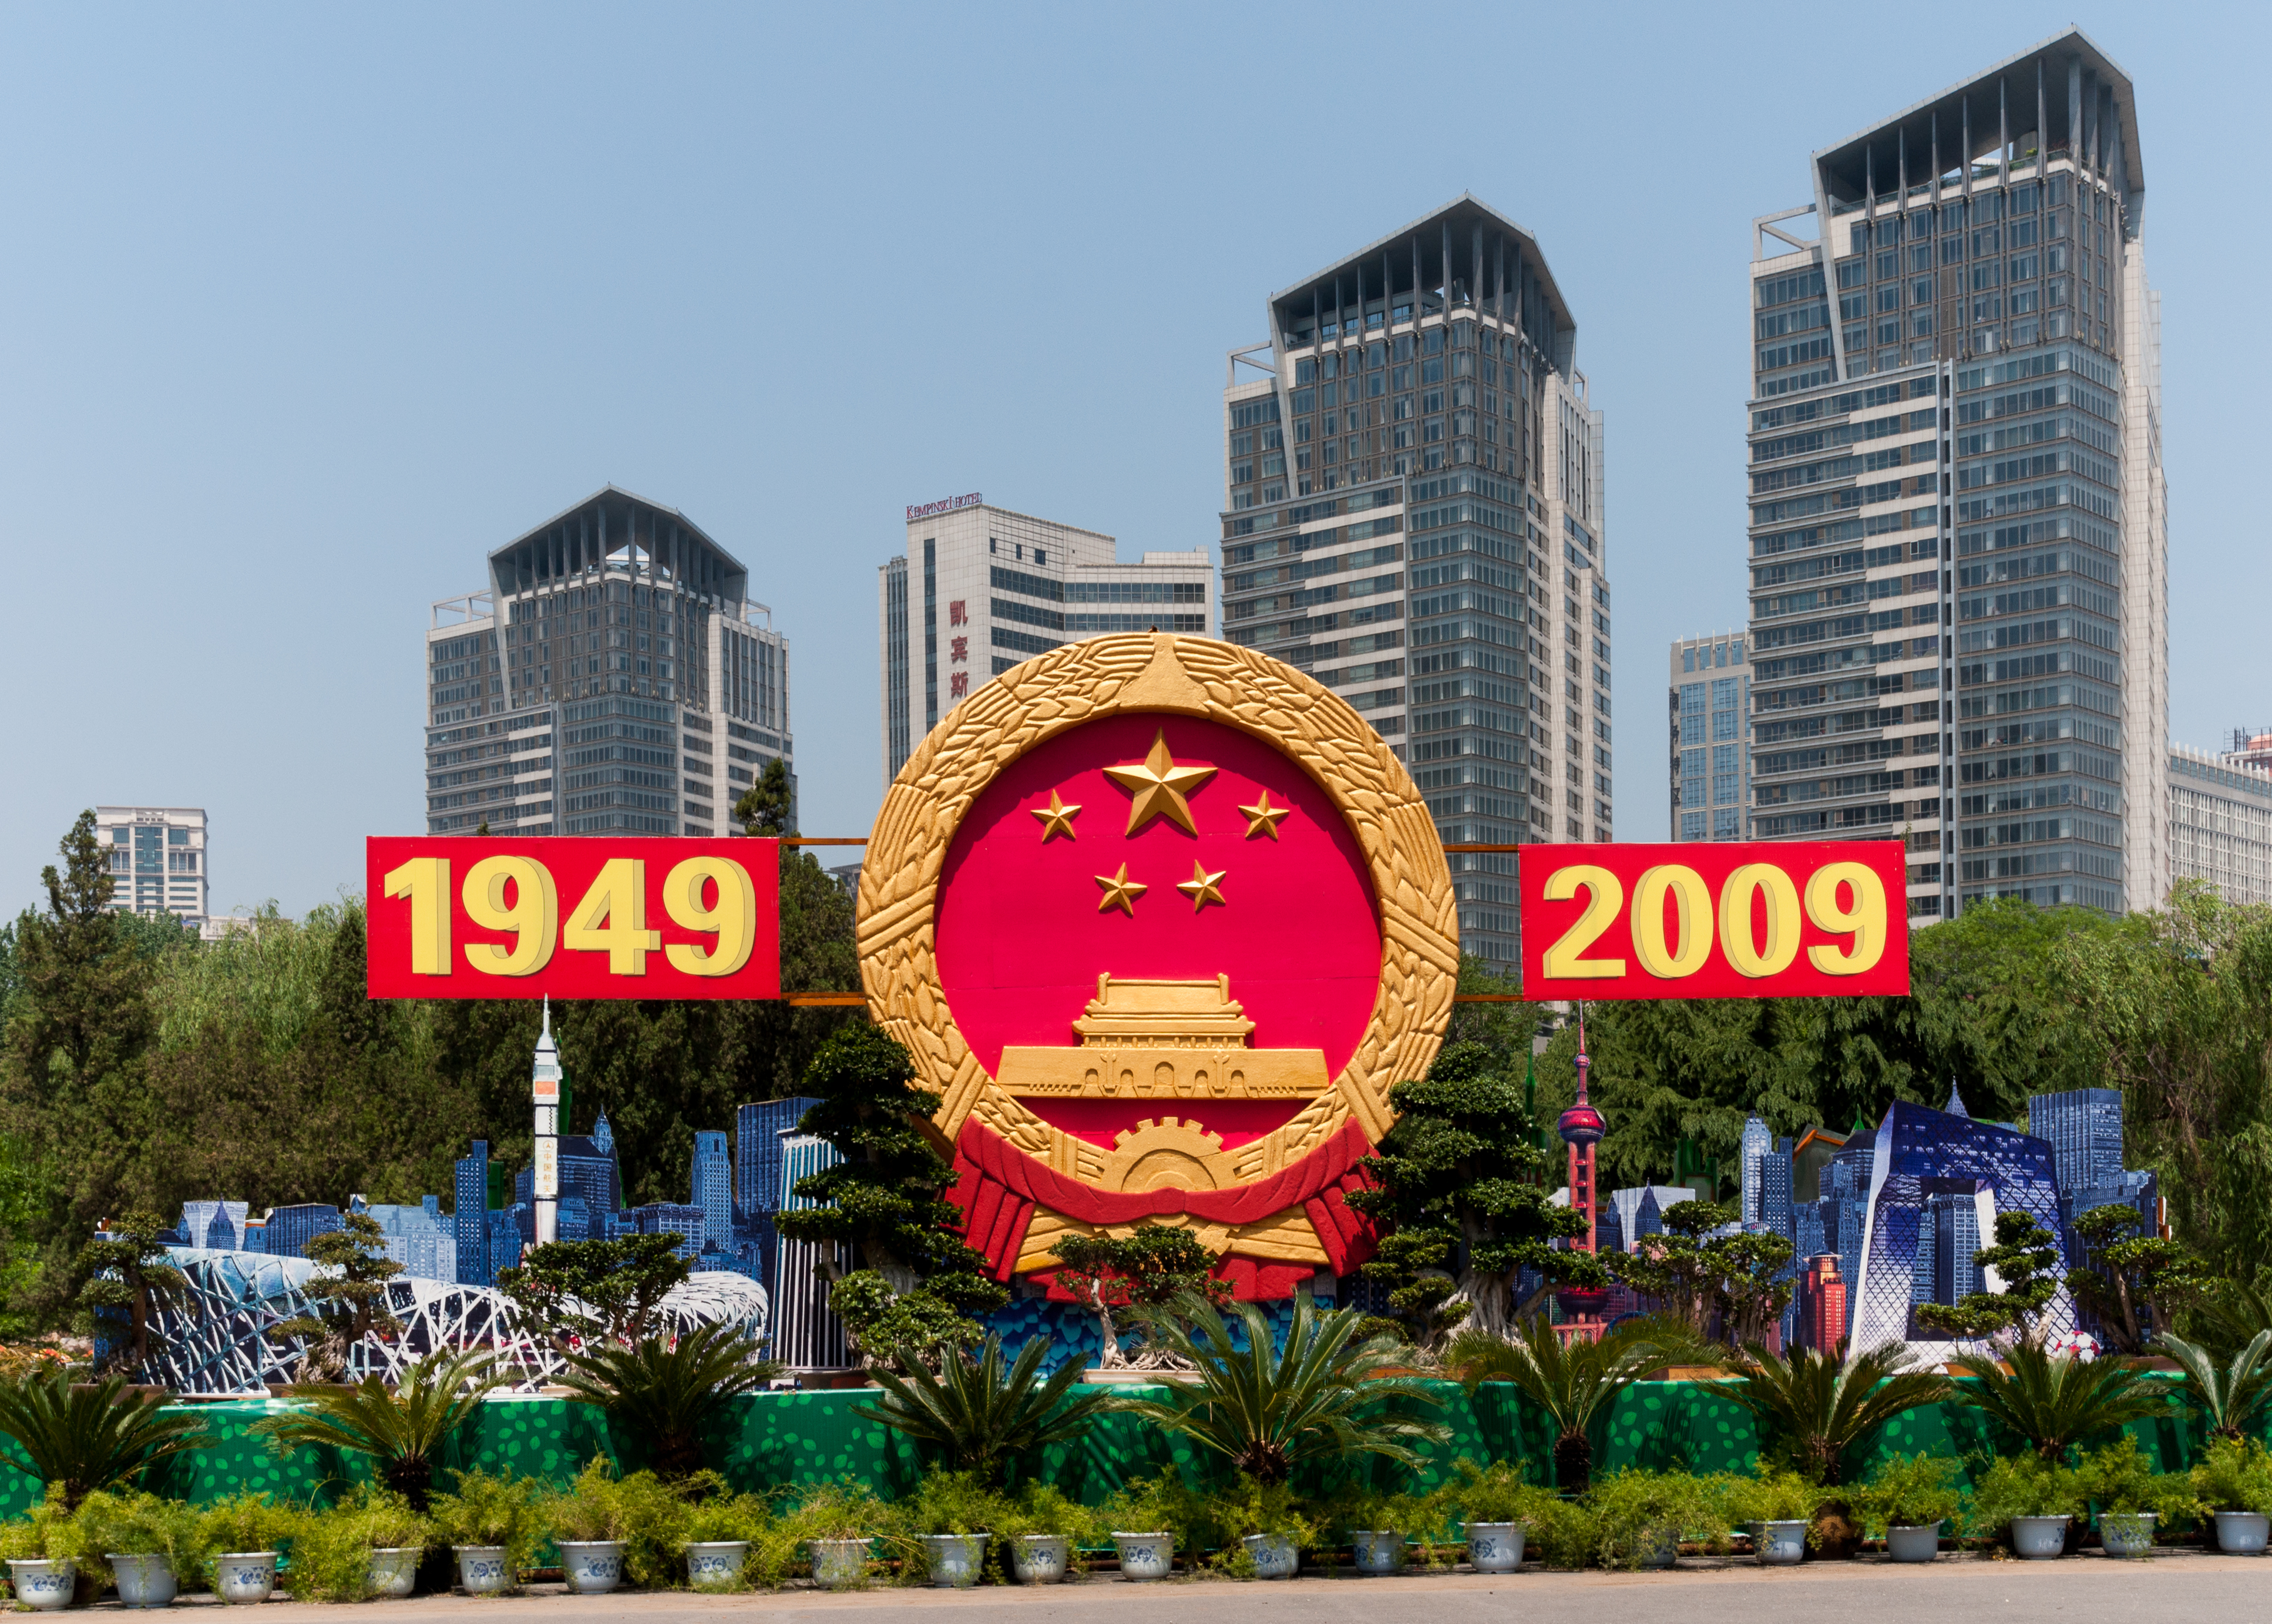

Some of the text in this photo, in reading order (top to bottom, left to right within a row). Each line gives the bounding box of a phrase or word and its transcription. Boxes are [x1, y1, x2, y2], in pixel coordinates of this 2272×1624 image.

[906, 492, 982, 519] KEMPINSKI HOTEL
[950, 600, 968, 698] 凯宾斯
[385, 855, 757, 976] 1949
[1542, 862, 1887, 979] 2009
[543, 1152, 552, 1193] 中国航天
